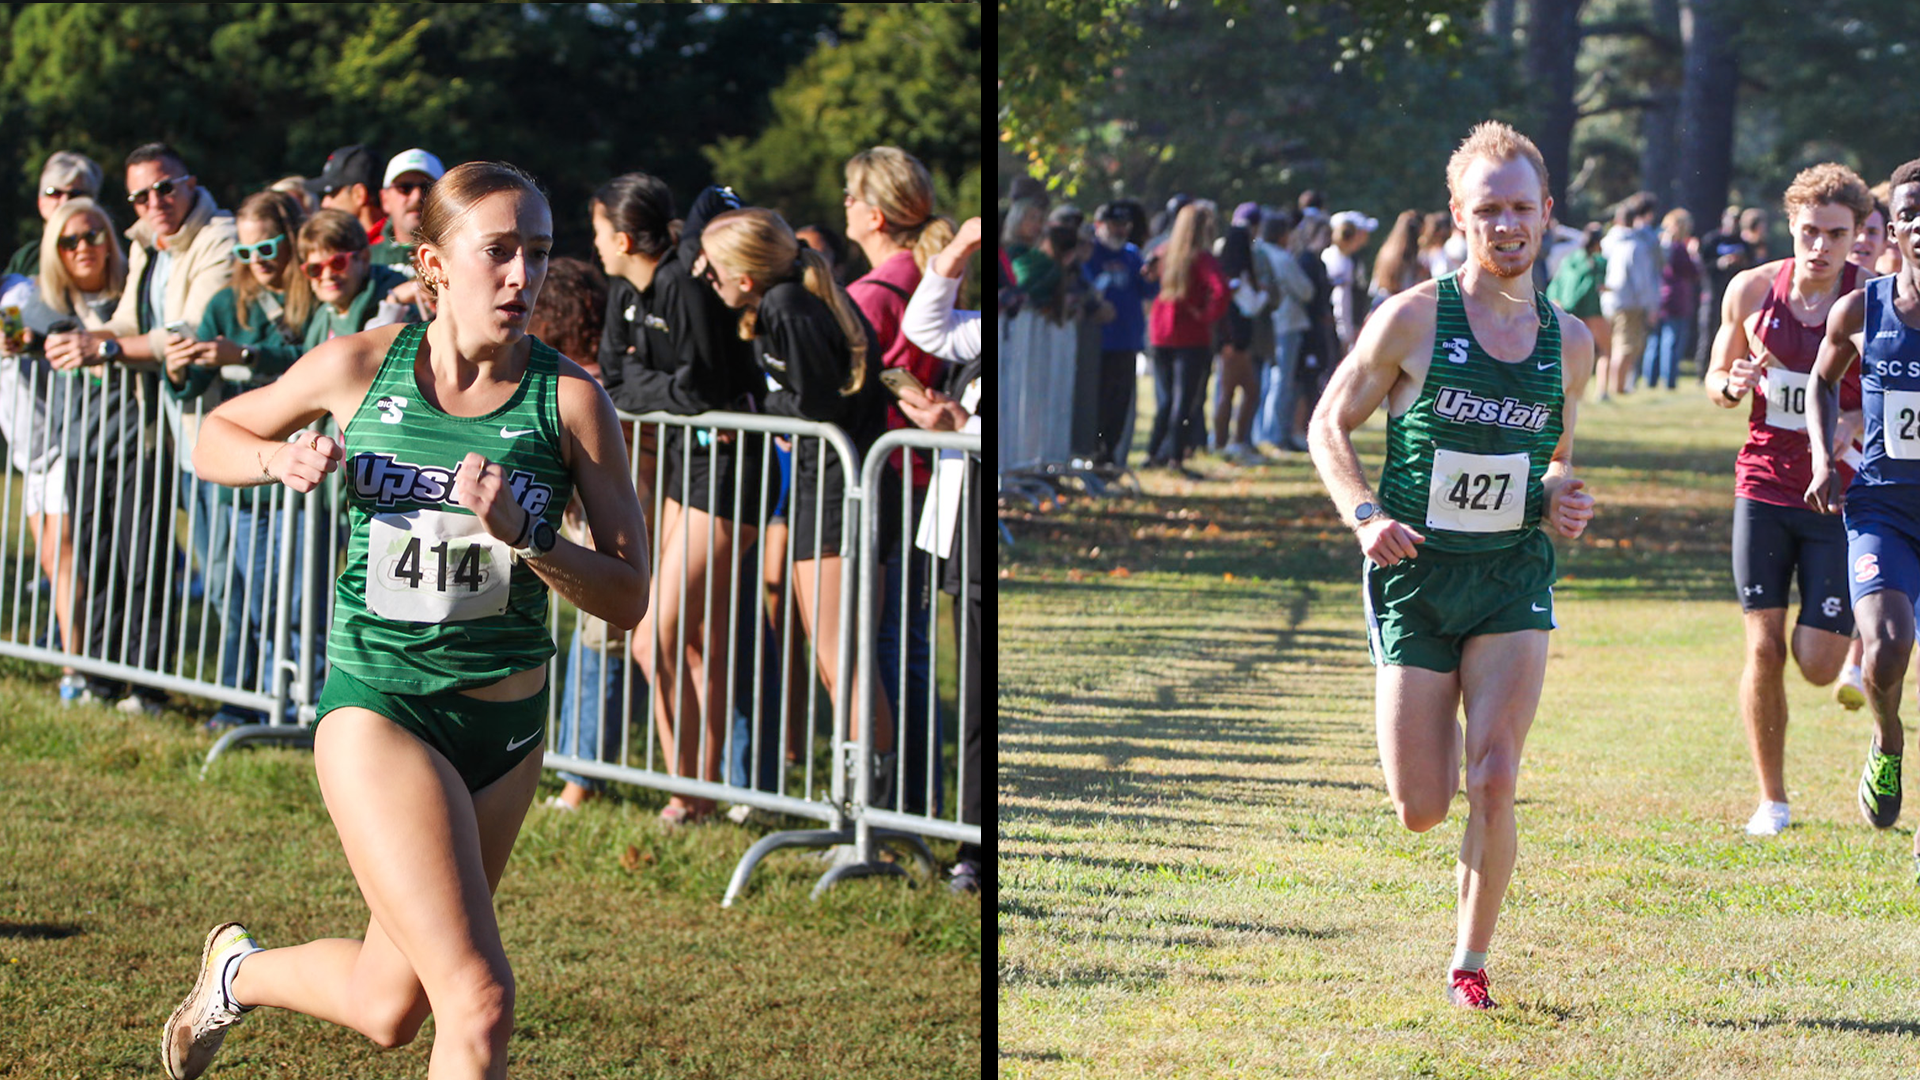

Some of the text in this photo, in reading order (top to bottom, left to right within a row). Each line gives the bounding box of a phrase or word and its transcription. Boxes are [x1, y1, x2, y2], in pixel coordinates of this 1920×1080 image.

[1876, 361, 1902, 376] SC
[1433, 386, 1552, 432] Upstate
[1900, 407, 1920, 440] 2
[353, 452, 553, 517] Upste
[1449, 473, 1510, 510] 427
[395, 537, 483, 592] 414
